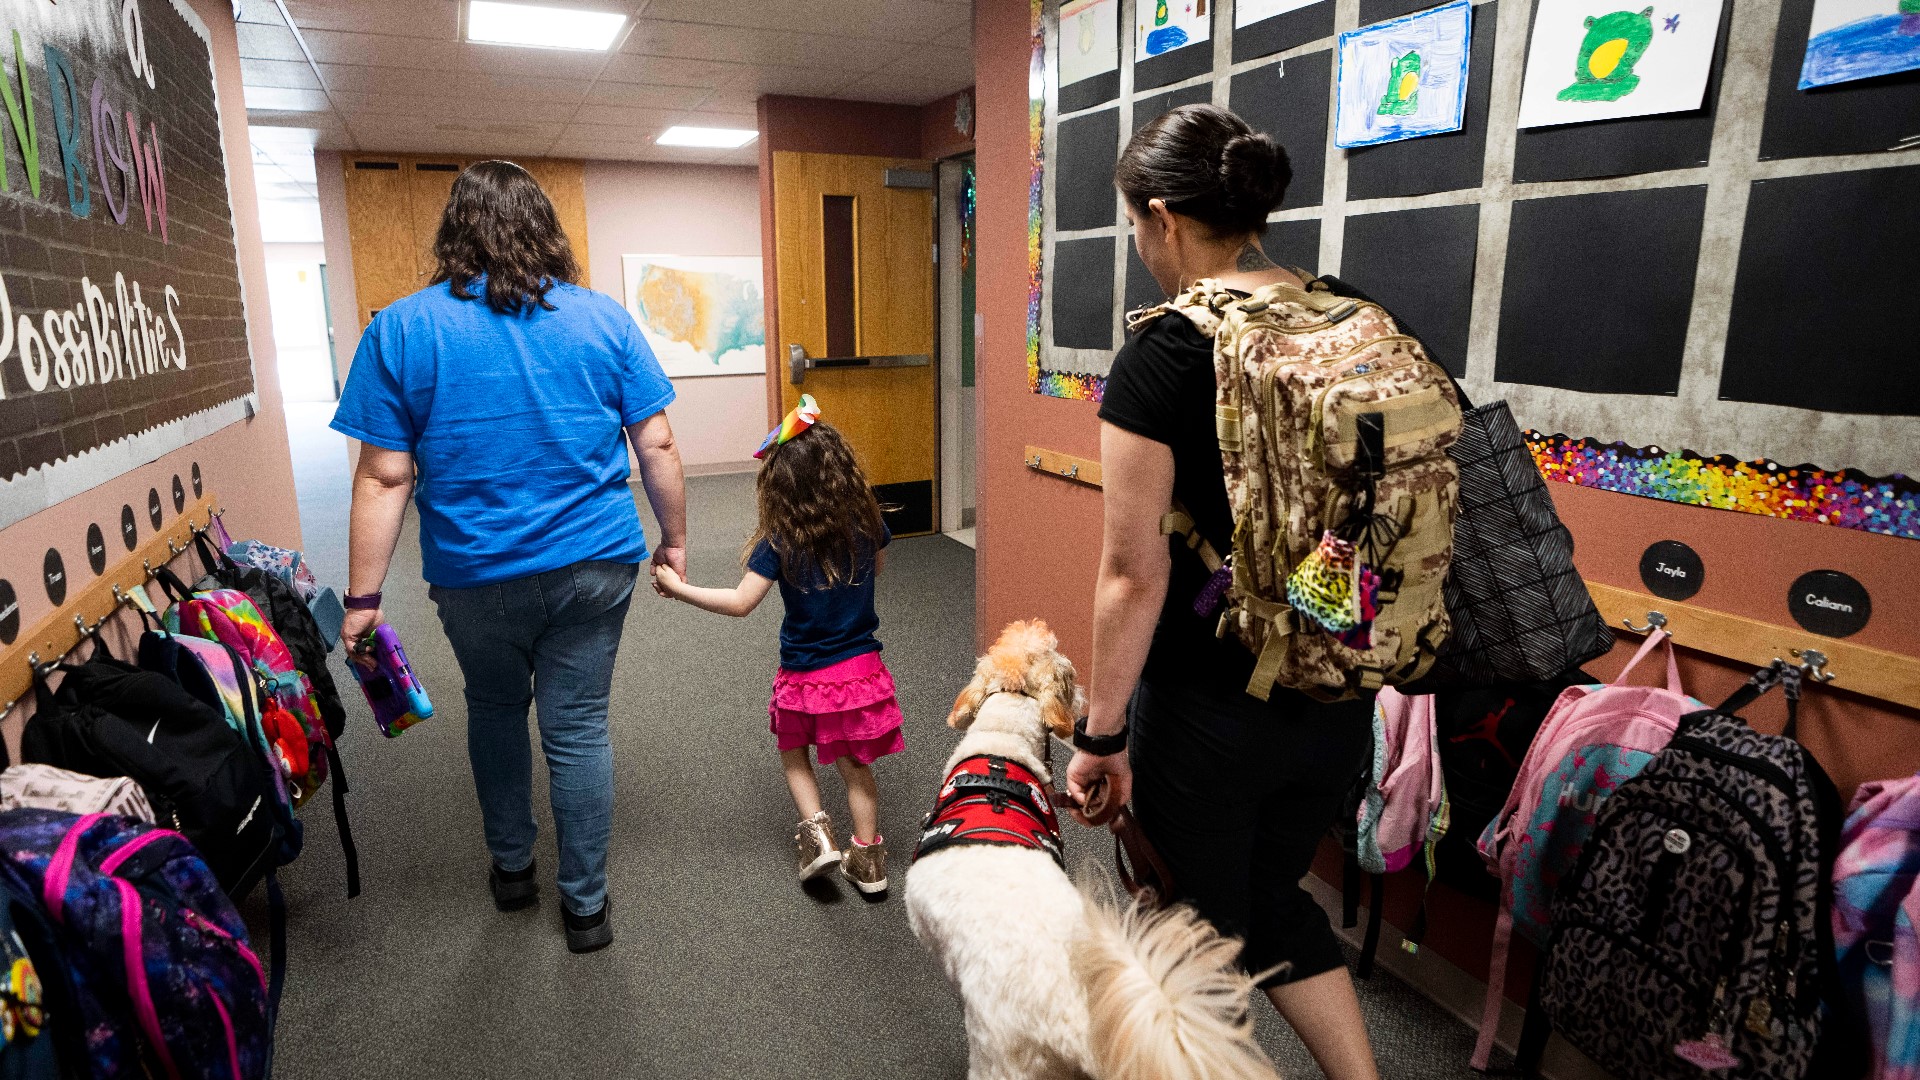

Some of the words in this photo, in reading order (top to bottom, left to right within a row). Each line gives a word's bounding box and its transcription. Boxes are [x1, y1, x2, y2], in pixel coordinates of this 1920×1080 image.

[122, 0, 155, 89] a
[1656, 562, 1686, 578] Jayla
[1805, 593, 1853, 613] Caliann
